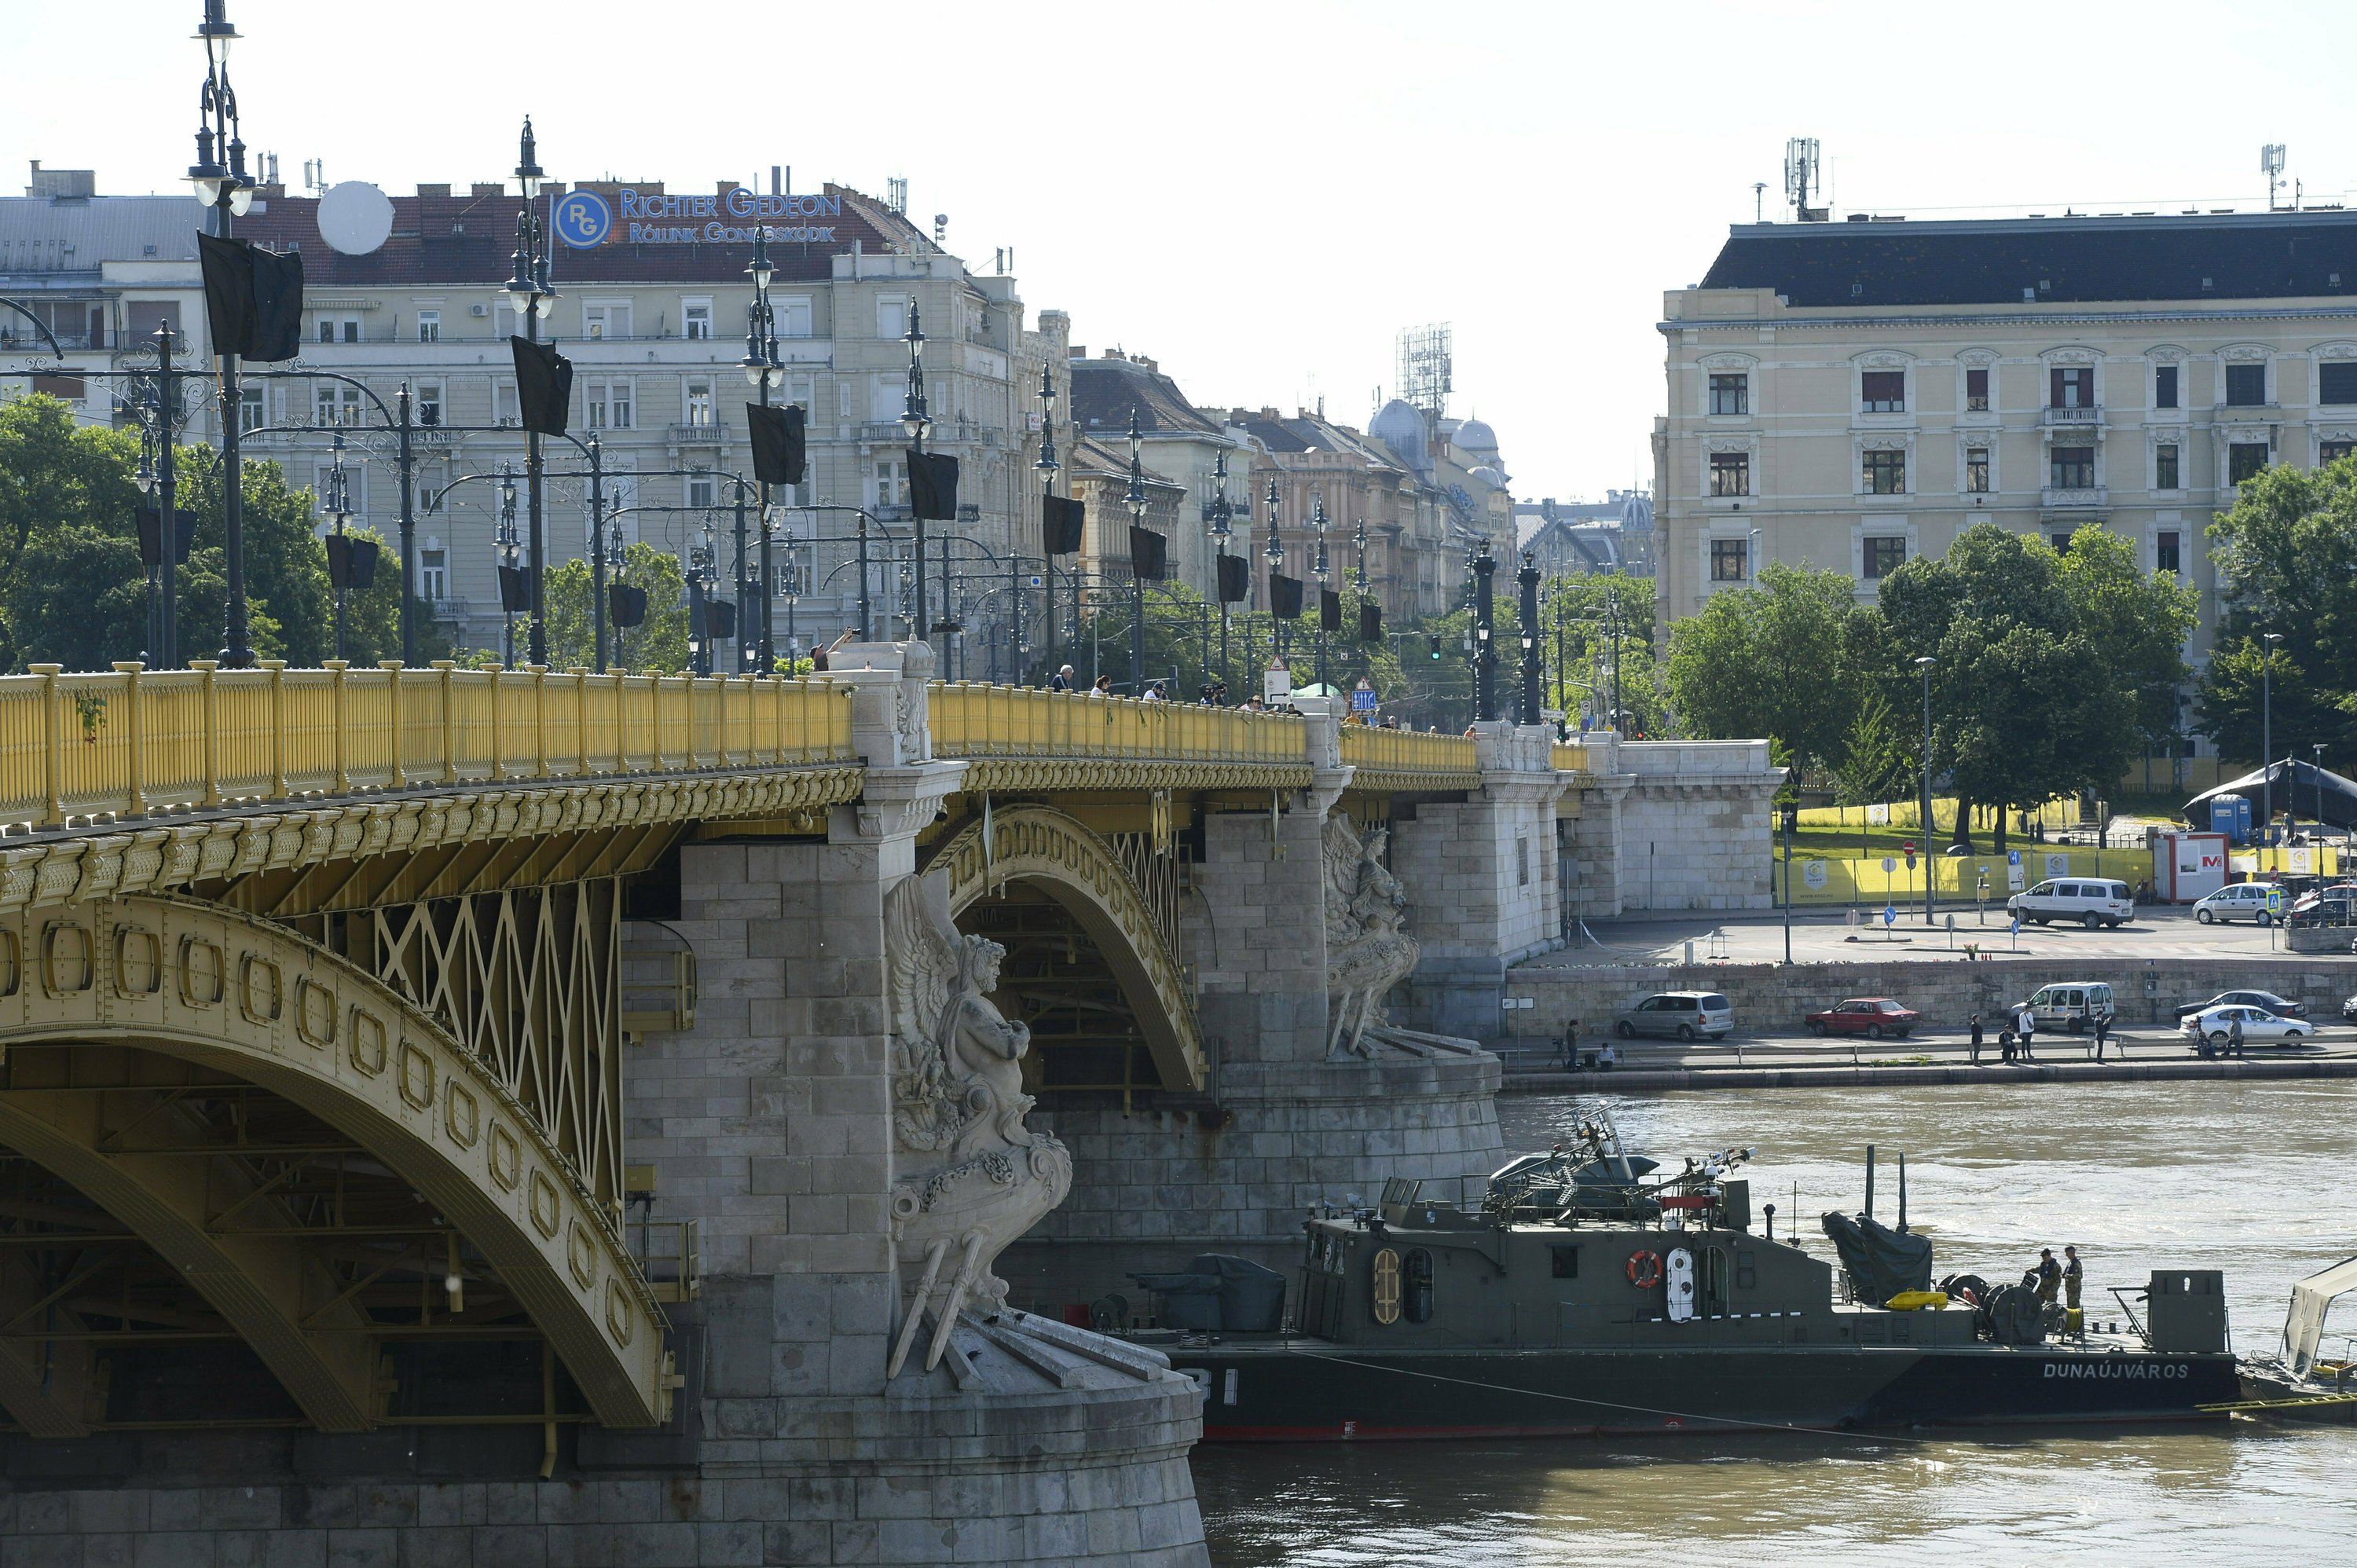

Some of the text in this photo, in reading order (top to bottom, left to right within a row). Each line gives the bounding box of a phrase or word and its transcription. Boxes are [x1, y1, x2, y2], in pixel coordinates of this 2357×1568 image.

[621, 188, 841, 218] RICHTER GEDEON
[570, 204, 597, 236] RG
[629, 222, 835, 243] RÓLUNK GONOSKODIK
[2044, 1360, 2189, 1379] DUNAÚJVÁROS
